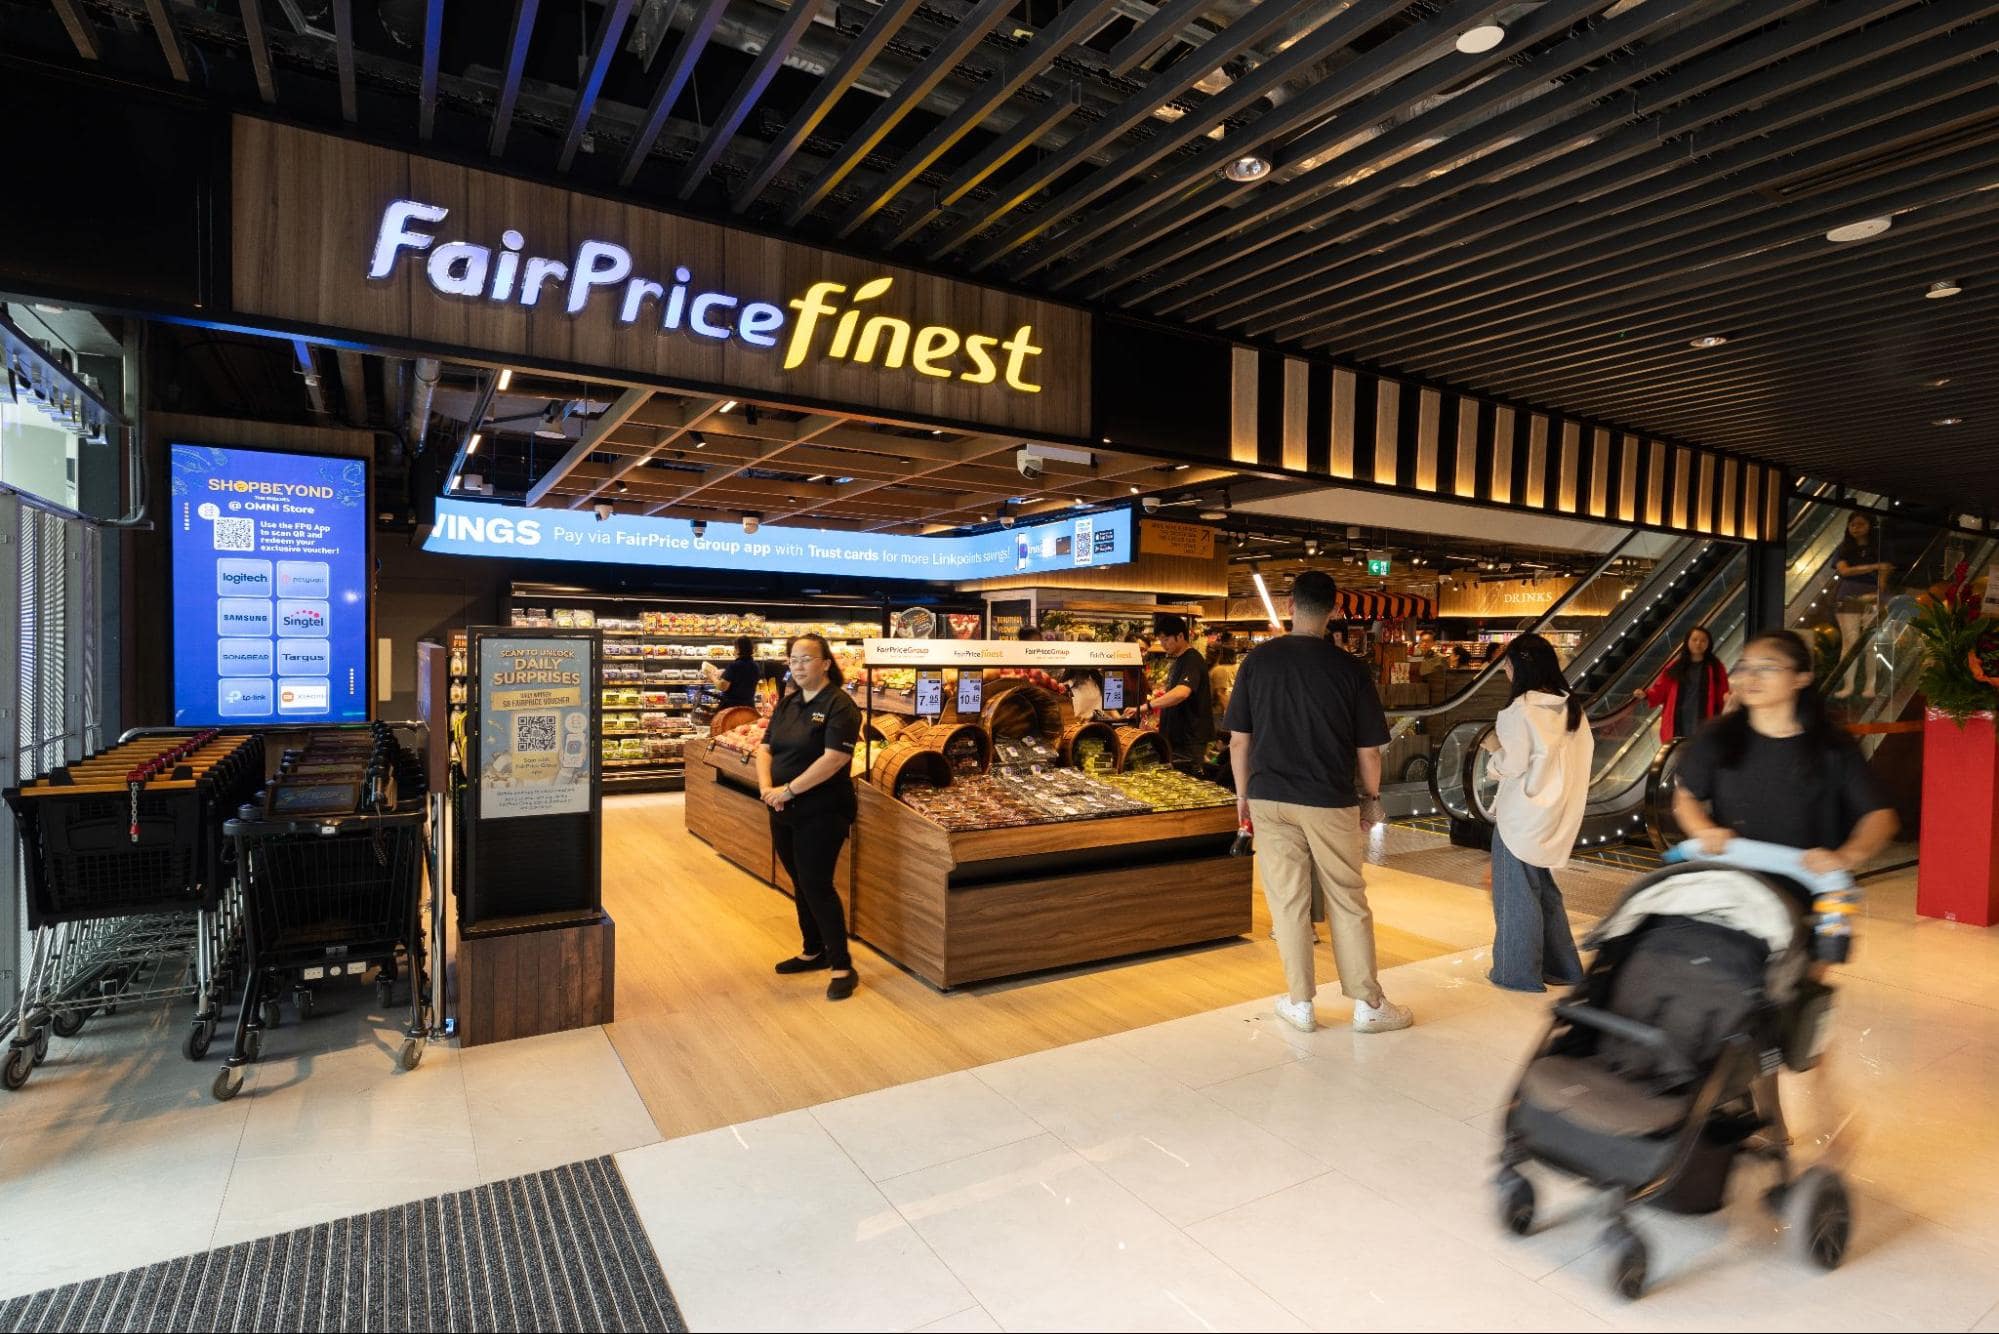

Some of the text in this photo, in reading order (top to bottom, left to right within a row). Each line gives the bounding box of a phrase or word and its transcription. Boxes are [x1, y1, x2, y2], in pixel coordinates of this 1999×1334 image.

[208, 478, 334, 499] SHOPBEYOND
[244, 502, 279, 512] OMNI
[283, 503, 315, 514] Store
[260, 521, 277, 529] Use
[279, 521, 293, 529] the
[314, 524, 330, 532] App
[303, 546, 340, 554] voucher!
[554, 527, 583, 545] Pay
[589, 529, 610, 544] via
[616, 531, 689, 549] FairPrice
[693, 537, 740, 555] Group
[744, 543, 771, 557] app
[775, 544, 803, 556] with
[808, 544, 841, 558] Trust
[844, 547, 878, 561] cards
[883, 551, 898, 563] for
[901, 554, 929, 565] more
[932, 552, 981, 567] Linkpoints
[223, 573, 268, 584] logitech
[1504, 592, 1553, 602] DRINKS
[223, 614, 268, 622] SAMSUNG
[283, 616, 324, 628] Singtel
[282, 654, 324, 662] Targus
[501, 649, 525, 657] SCAN
[540, 649, 576, 658] UNLOCK
[515, 657, 562, 671] DAILY
[493, 671, 581, 685] SURPRISES
[242, 694, 266, 702] tp-link
